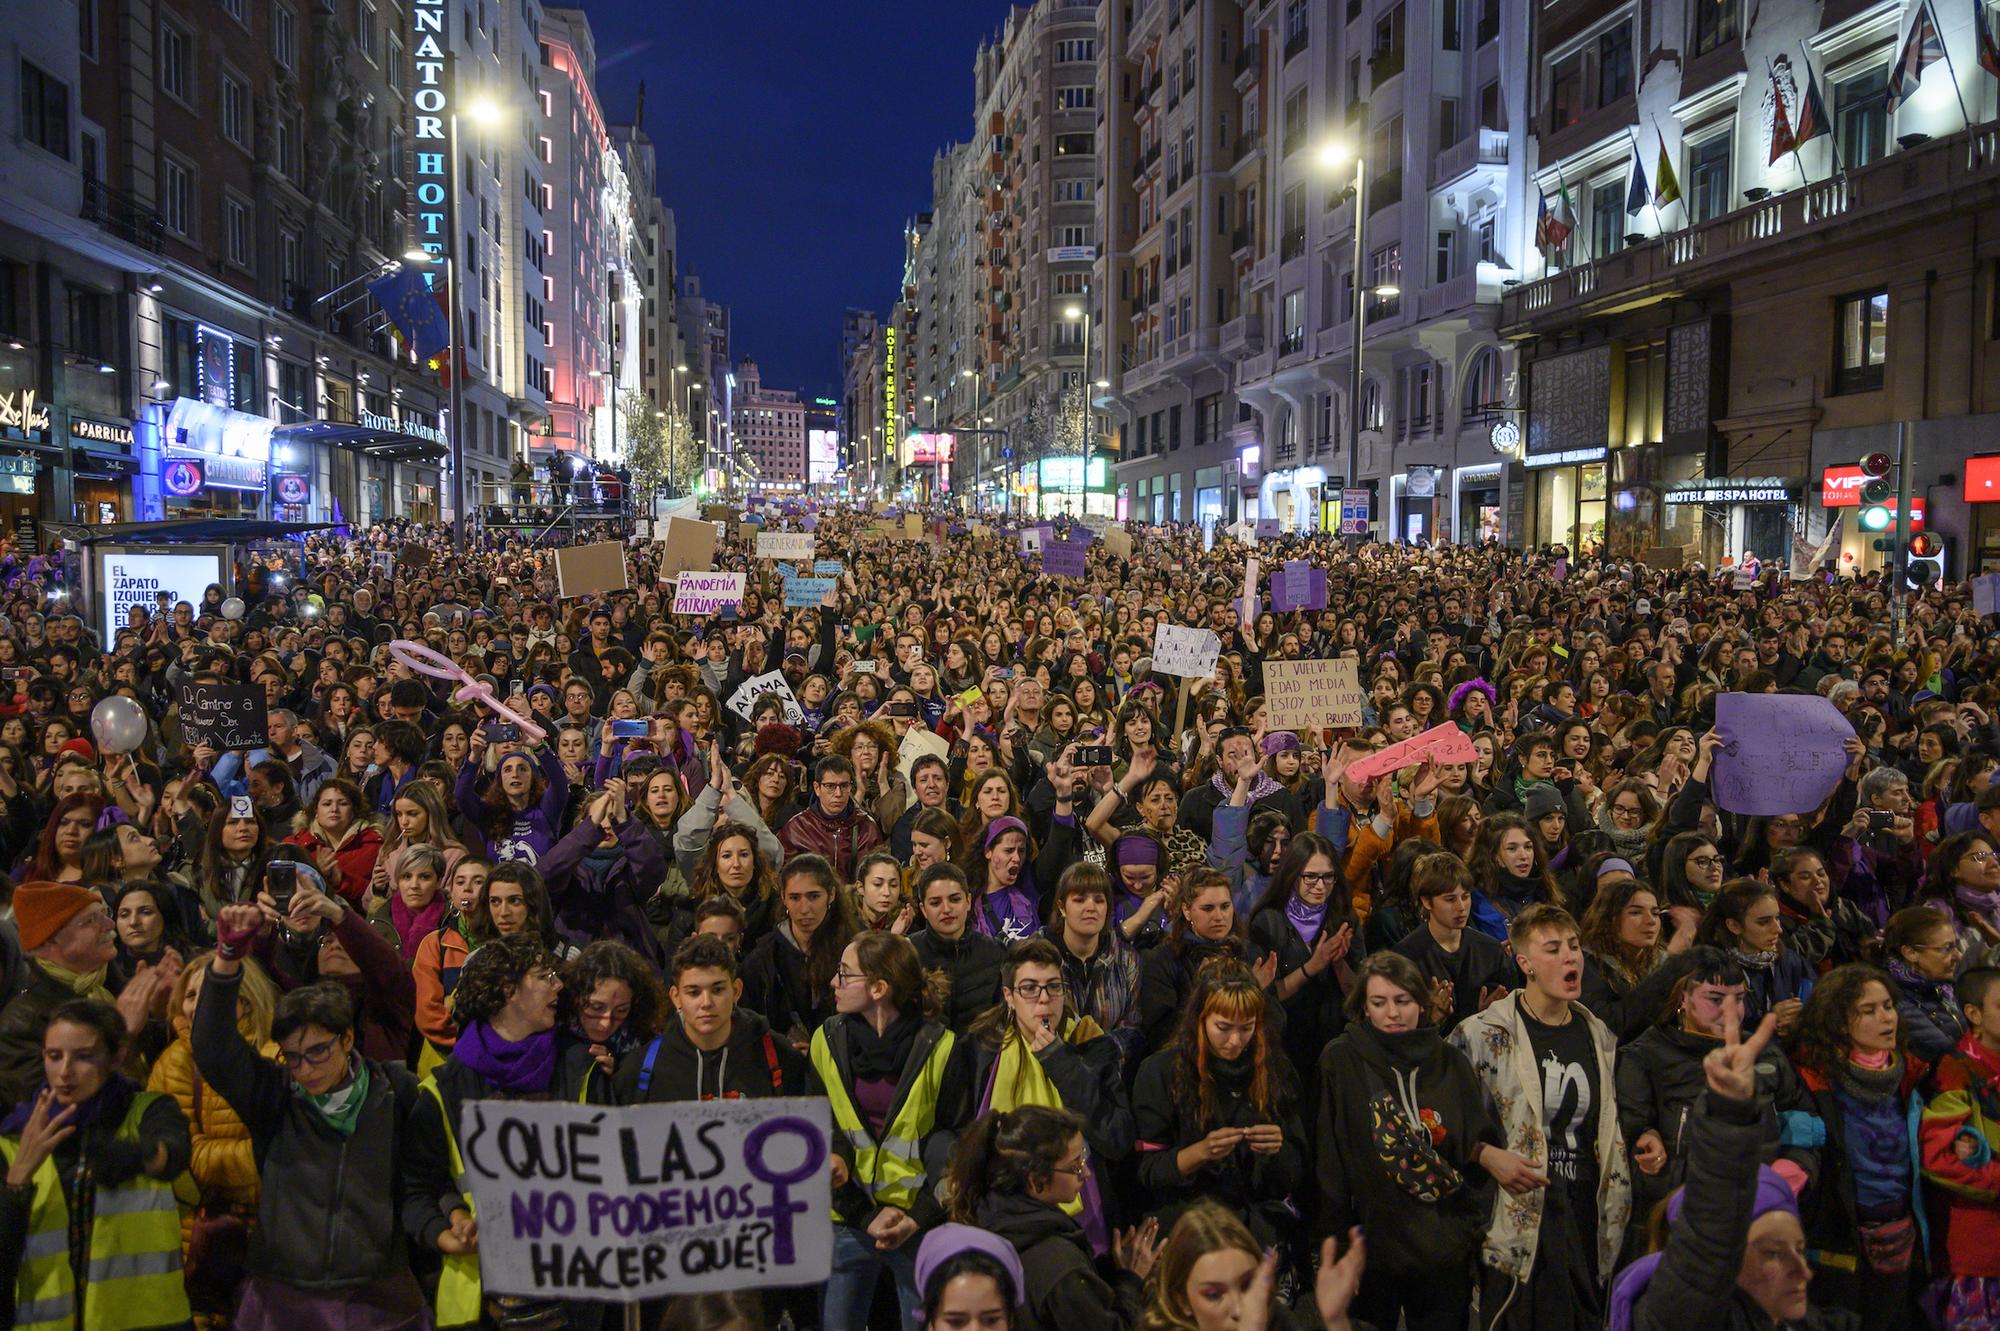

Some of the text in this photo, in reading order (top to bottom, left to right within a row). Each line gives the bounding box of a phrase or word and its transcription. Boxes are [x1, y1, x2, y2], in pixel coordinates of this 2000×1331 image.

[886, 328, 896, 456] HOTEL EMPERADOR
[80, 421, 135, 444] PARRILLA
[364, 413, 400, 433] HOTEL
[403, 420, 435, 441] SENATOR
[112, 566, 127, 577] EL
[113, 578, 159, 589] ZAPATO
[113, 590, 178, 602] IZQUIERO
[114, 603, 129, 614] ES
[1269, 661, 1349, 678] SI VUELVE LA
[1271, 678, 1346, 695] EDAD MEDIA
[196, 687, 232, 710] Camino
[243, 698, 253, 710] a
[1271, 693, 1361, 710] ESTOY DEL LADO
[1272, 710, 1362, 727] DE LAS BRUJAS
[214, 728, 265, 747] Valiente
[466, 1105, 725, 1186] ¿QUÉ LAS
[511, 1182, 754, 1240] NO PODEMOS
[531, 1221, 773, 1290] HACER QUÉ?
